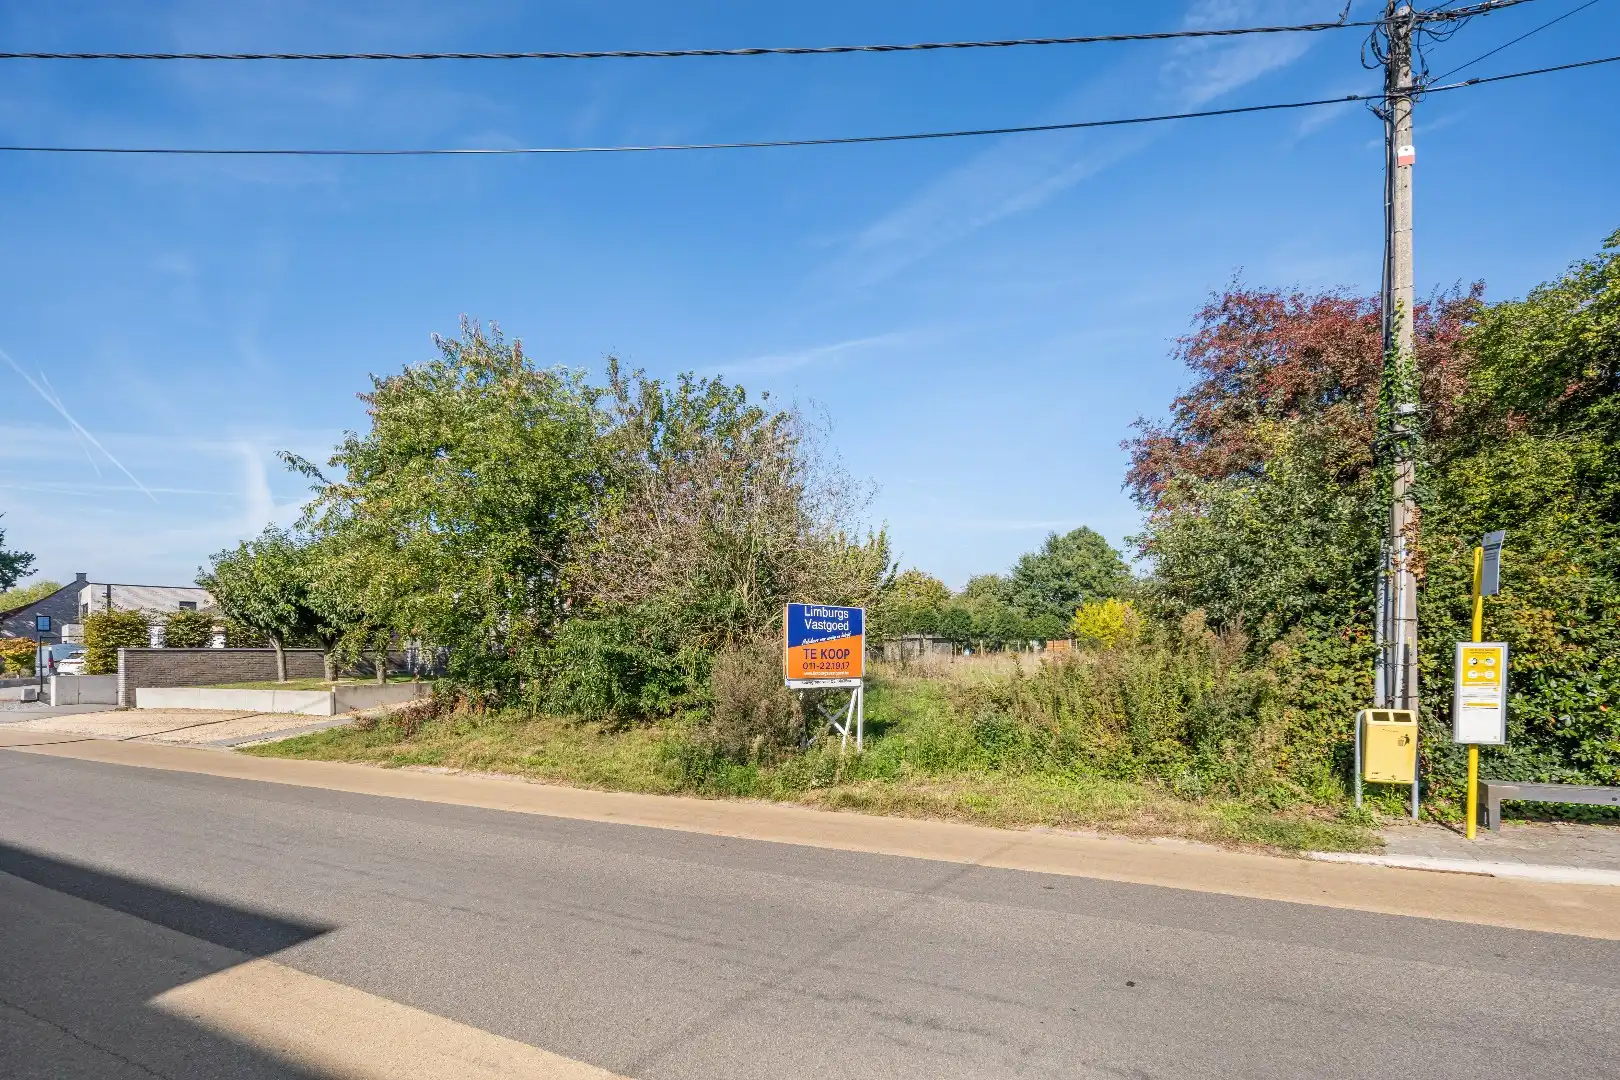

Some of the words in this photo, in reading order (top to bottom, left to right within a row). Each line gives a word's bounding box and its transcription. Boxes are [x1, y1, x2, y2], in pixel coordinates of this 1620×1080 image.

[805, 606, 849, 620] Limburgs
[804, 619, 849, 633] Vastgoed
[803, 649, 817, 659] TE
[820, 649, 850, 659] KOOP
[802, 661, 850, 670] 011-22.19.17
